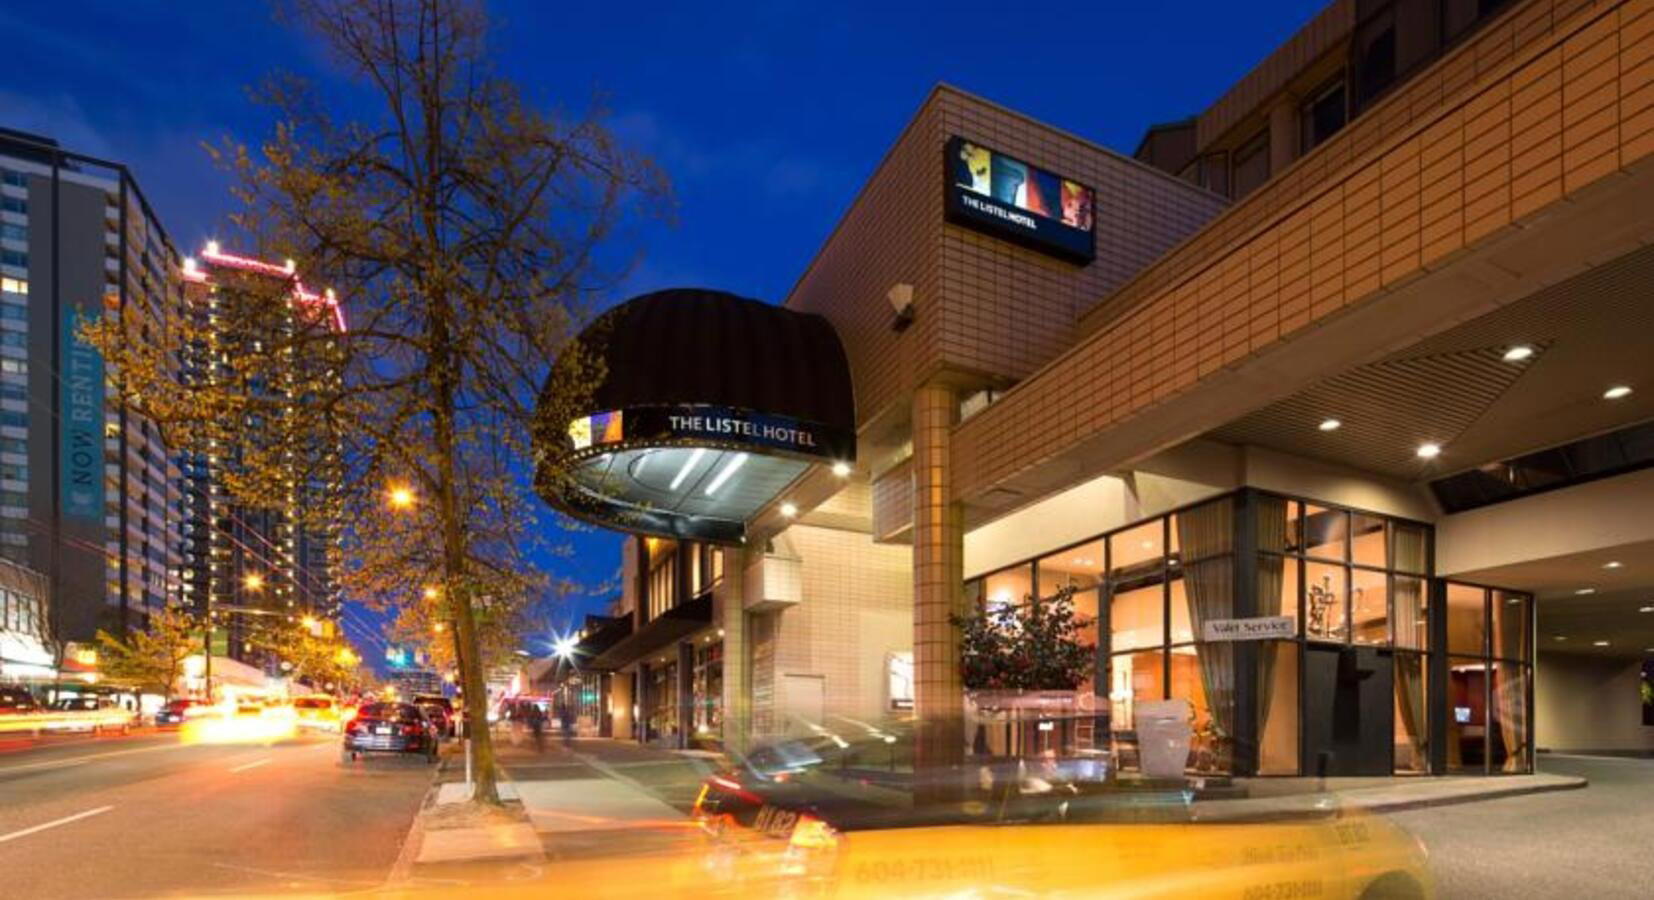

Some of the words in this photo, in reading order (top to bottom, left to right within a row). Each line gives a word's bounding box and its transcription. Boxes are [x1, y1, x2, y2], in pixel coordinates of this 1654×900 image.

[962, 194, 979, 209] THE
[979, 201, 1008, 219] LISTEL
[1008, 211, 1037, 229] HOTEL
[71, 336, 94, 422] RENTI
[669, 415, 702, 430] THE
[705, 417, 761, 437] LISTEL
[763, 424, 816, 447] HOTEL
[71, 430, 94, 485] NOW
[1213, 622, 1239, 634] Valet
[1244, 621, 1288, 632] Service
